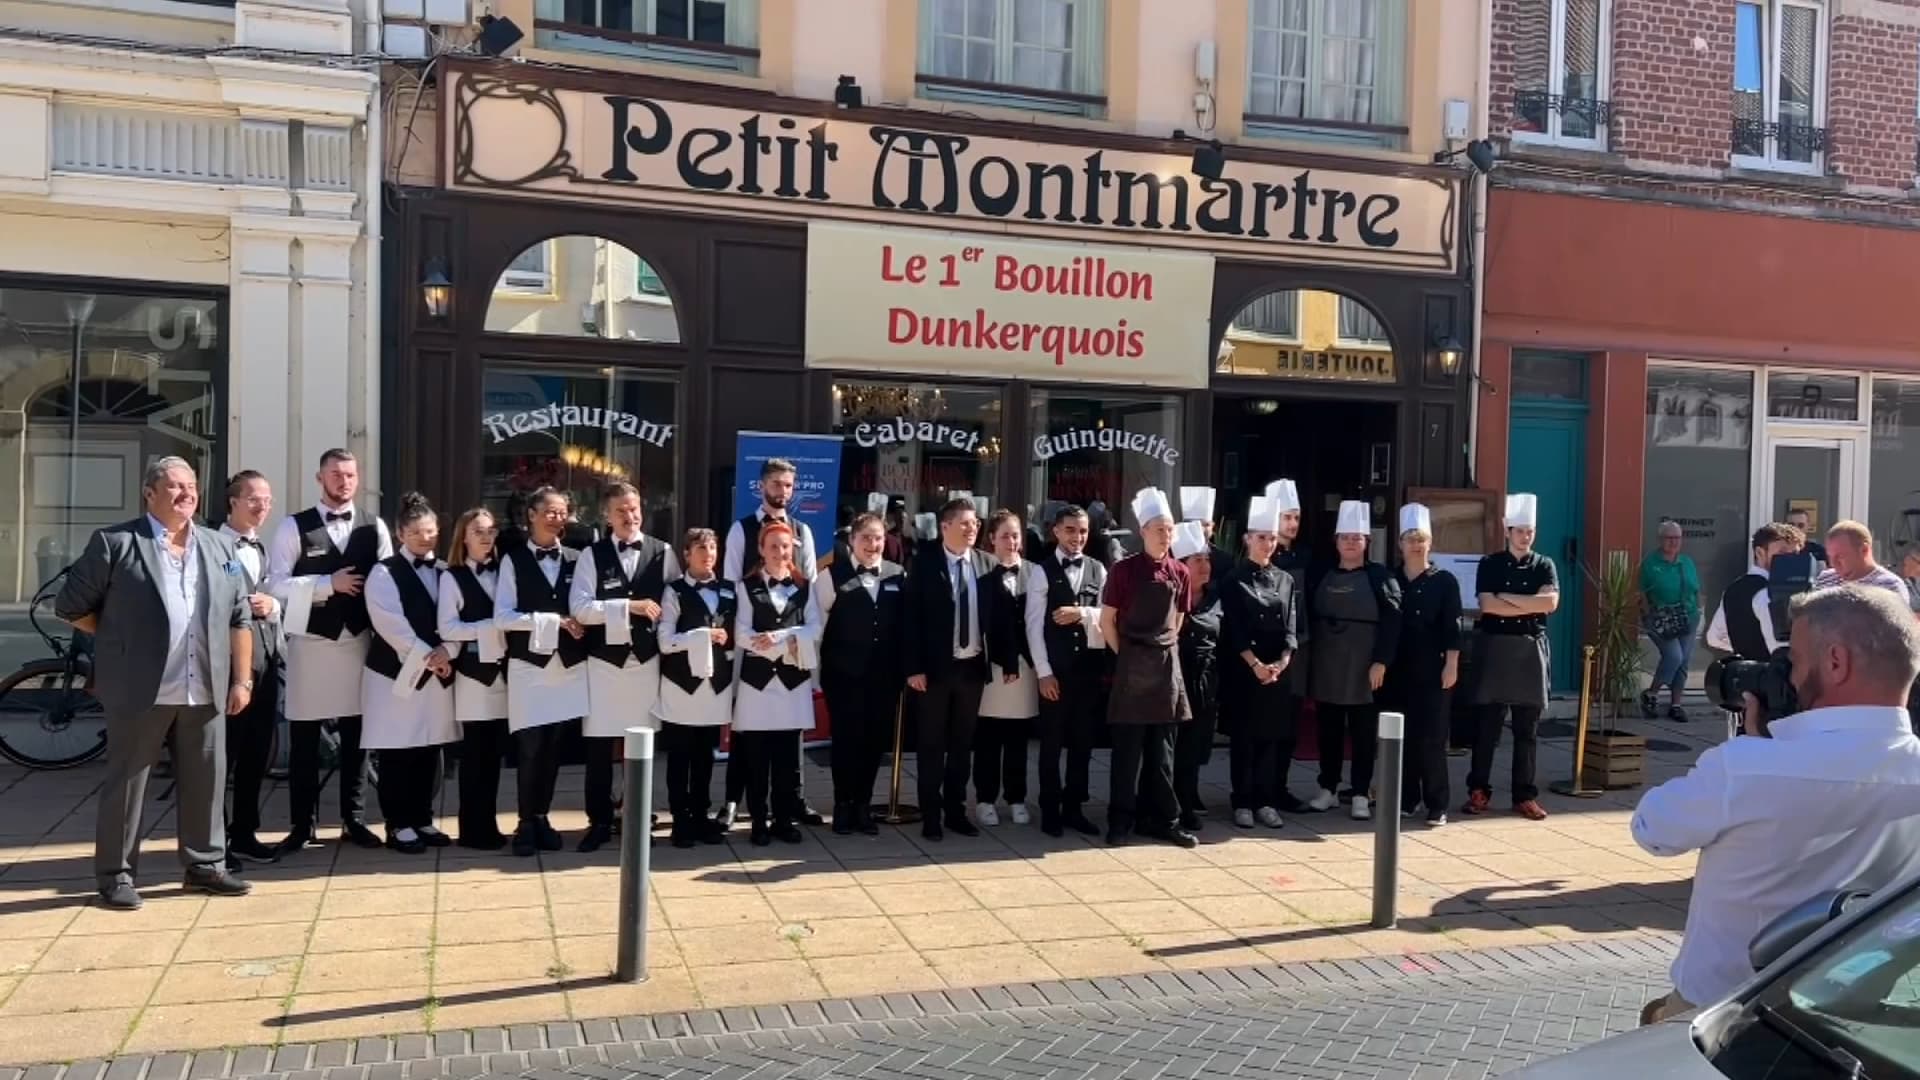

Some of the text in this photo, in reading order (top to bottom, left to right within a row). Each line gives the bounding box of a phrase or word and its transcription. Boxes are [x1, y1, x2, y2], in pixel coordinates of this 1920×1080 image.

[601, 96, 1400, 248] Petit Montmartre
[881, 245, 1153, 300] Le 1er Bouillon
[887, 307, 1145, 365] Dunkerquois
[482, 401, 673, 447] Restaurant
[855, 416, 980, 453] Cabaret
[1034, 426, 1180, 466] Guinguette
[1431, 423, 1439, 438] 7
